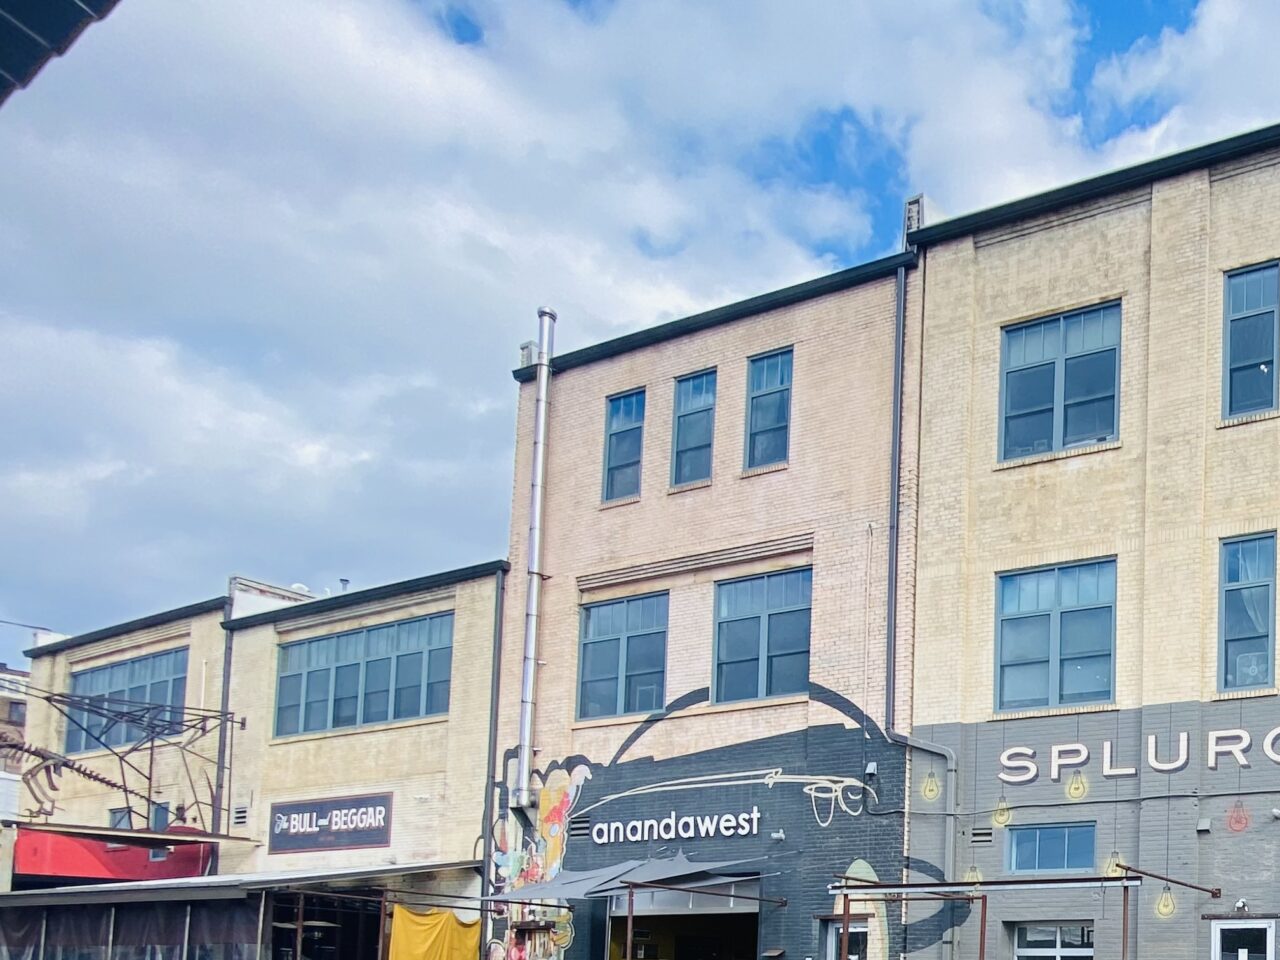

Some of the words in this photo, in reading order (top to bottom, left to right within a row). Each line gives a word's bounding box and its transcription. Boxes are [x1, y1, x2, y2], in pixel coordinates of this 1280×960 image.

[289, 811, 319, 833] BULL
[331, 805, 386, 830] BEGGAR
[592, 805, 761, 845] anandawest
